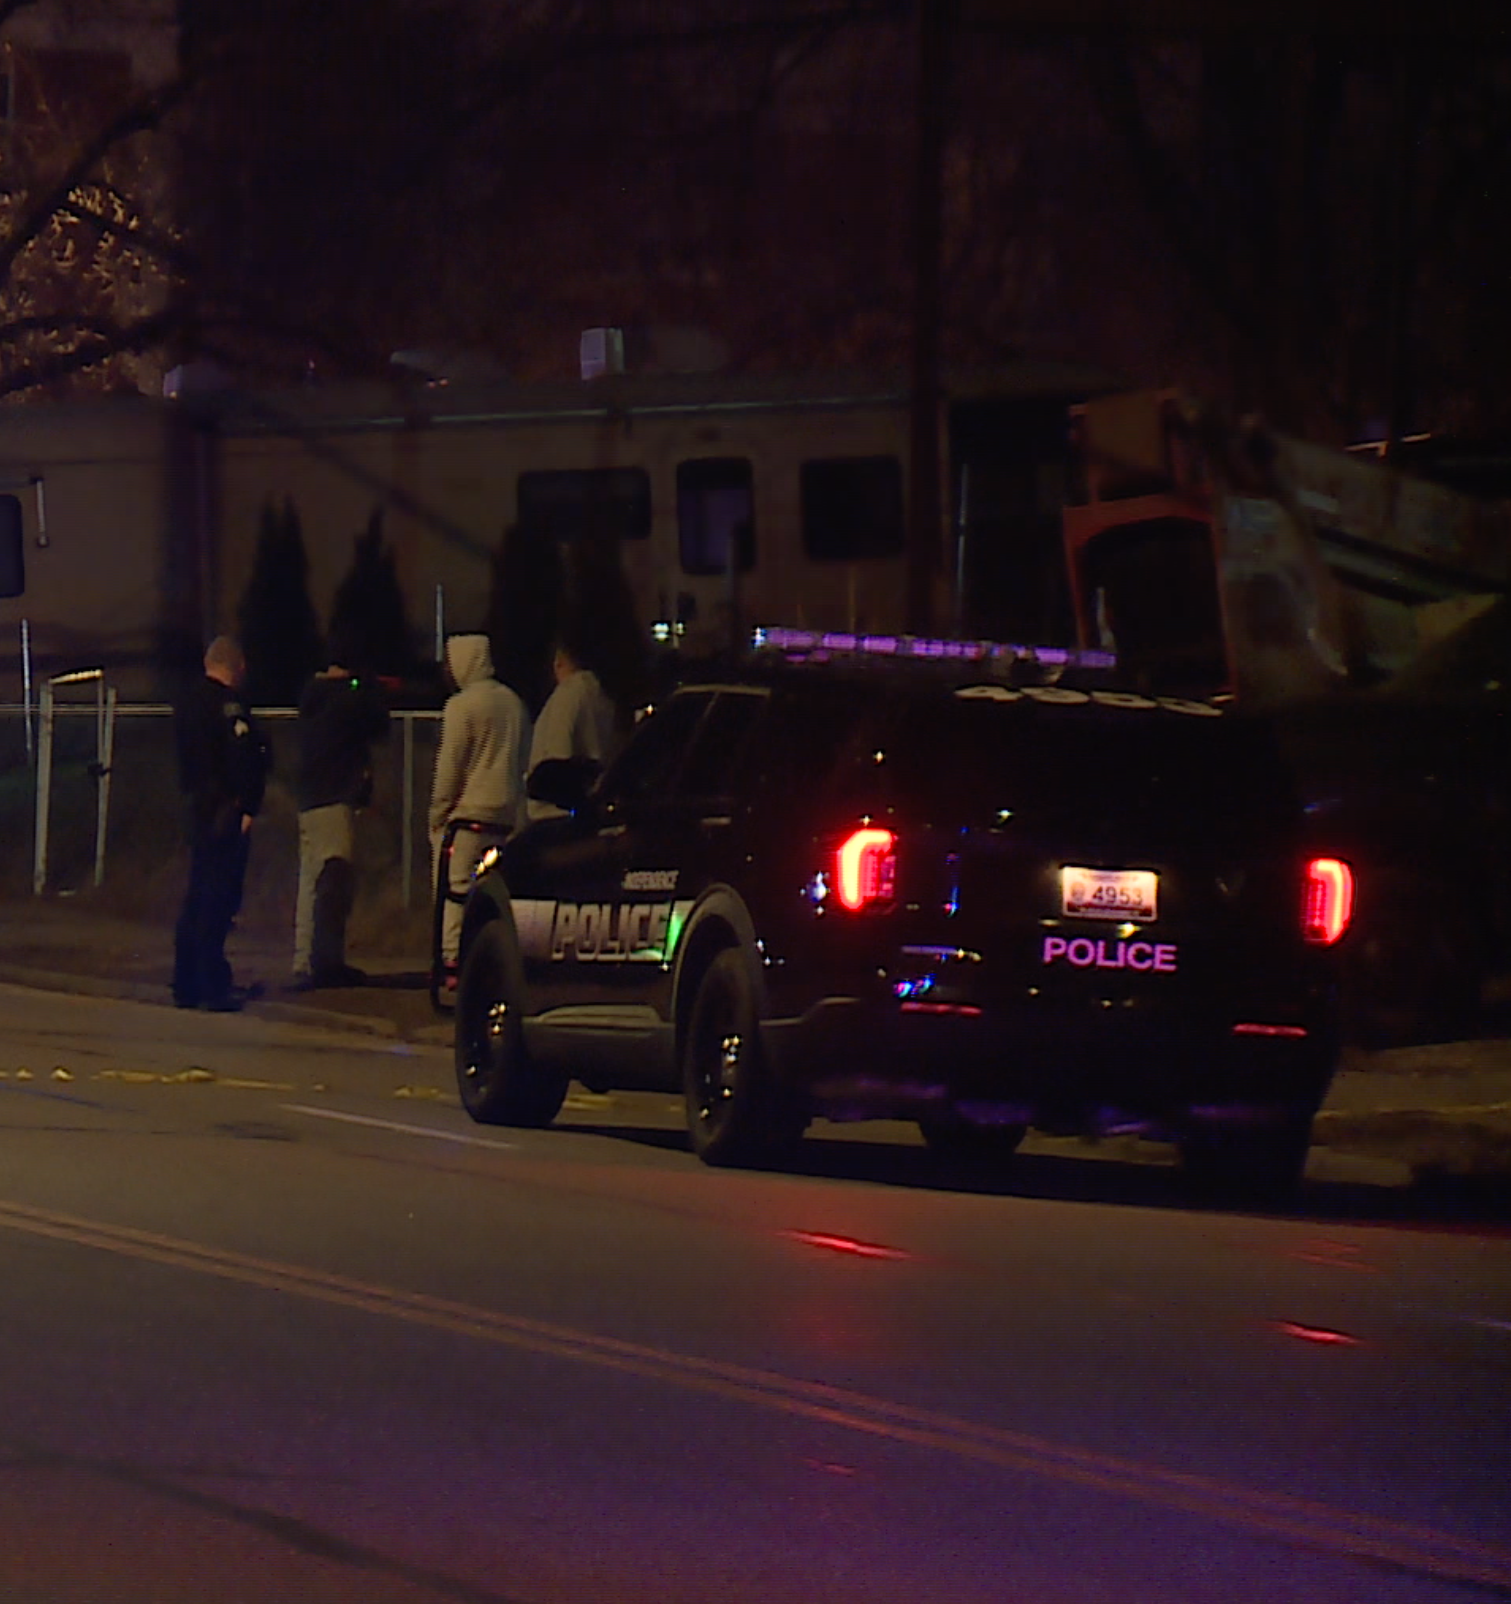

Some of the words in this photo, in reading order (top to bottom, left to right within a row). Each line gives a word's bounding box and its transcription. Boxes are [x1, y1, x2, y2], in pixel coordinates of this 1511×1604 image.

[1091, 885, 1144, 906] 4953
[551, 902, 672, 962] POLICE
[1043, 936, 1178, 973] POLICE
